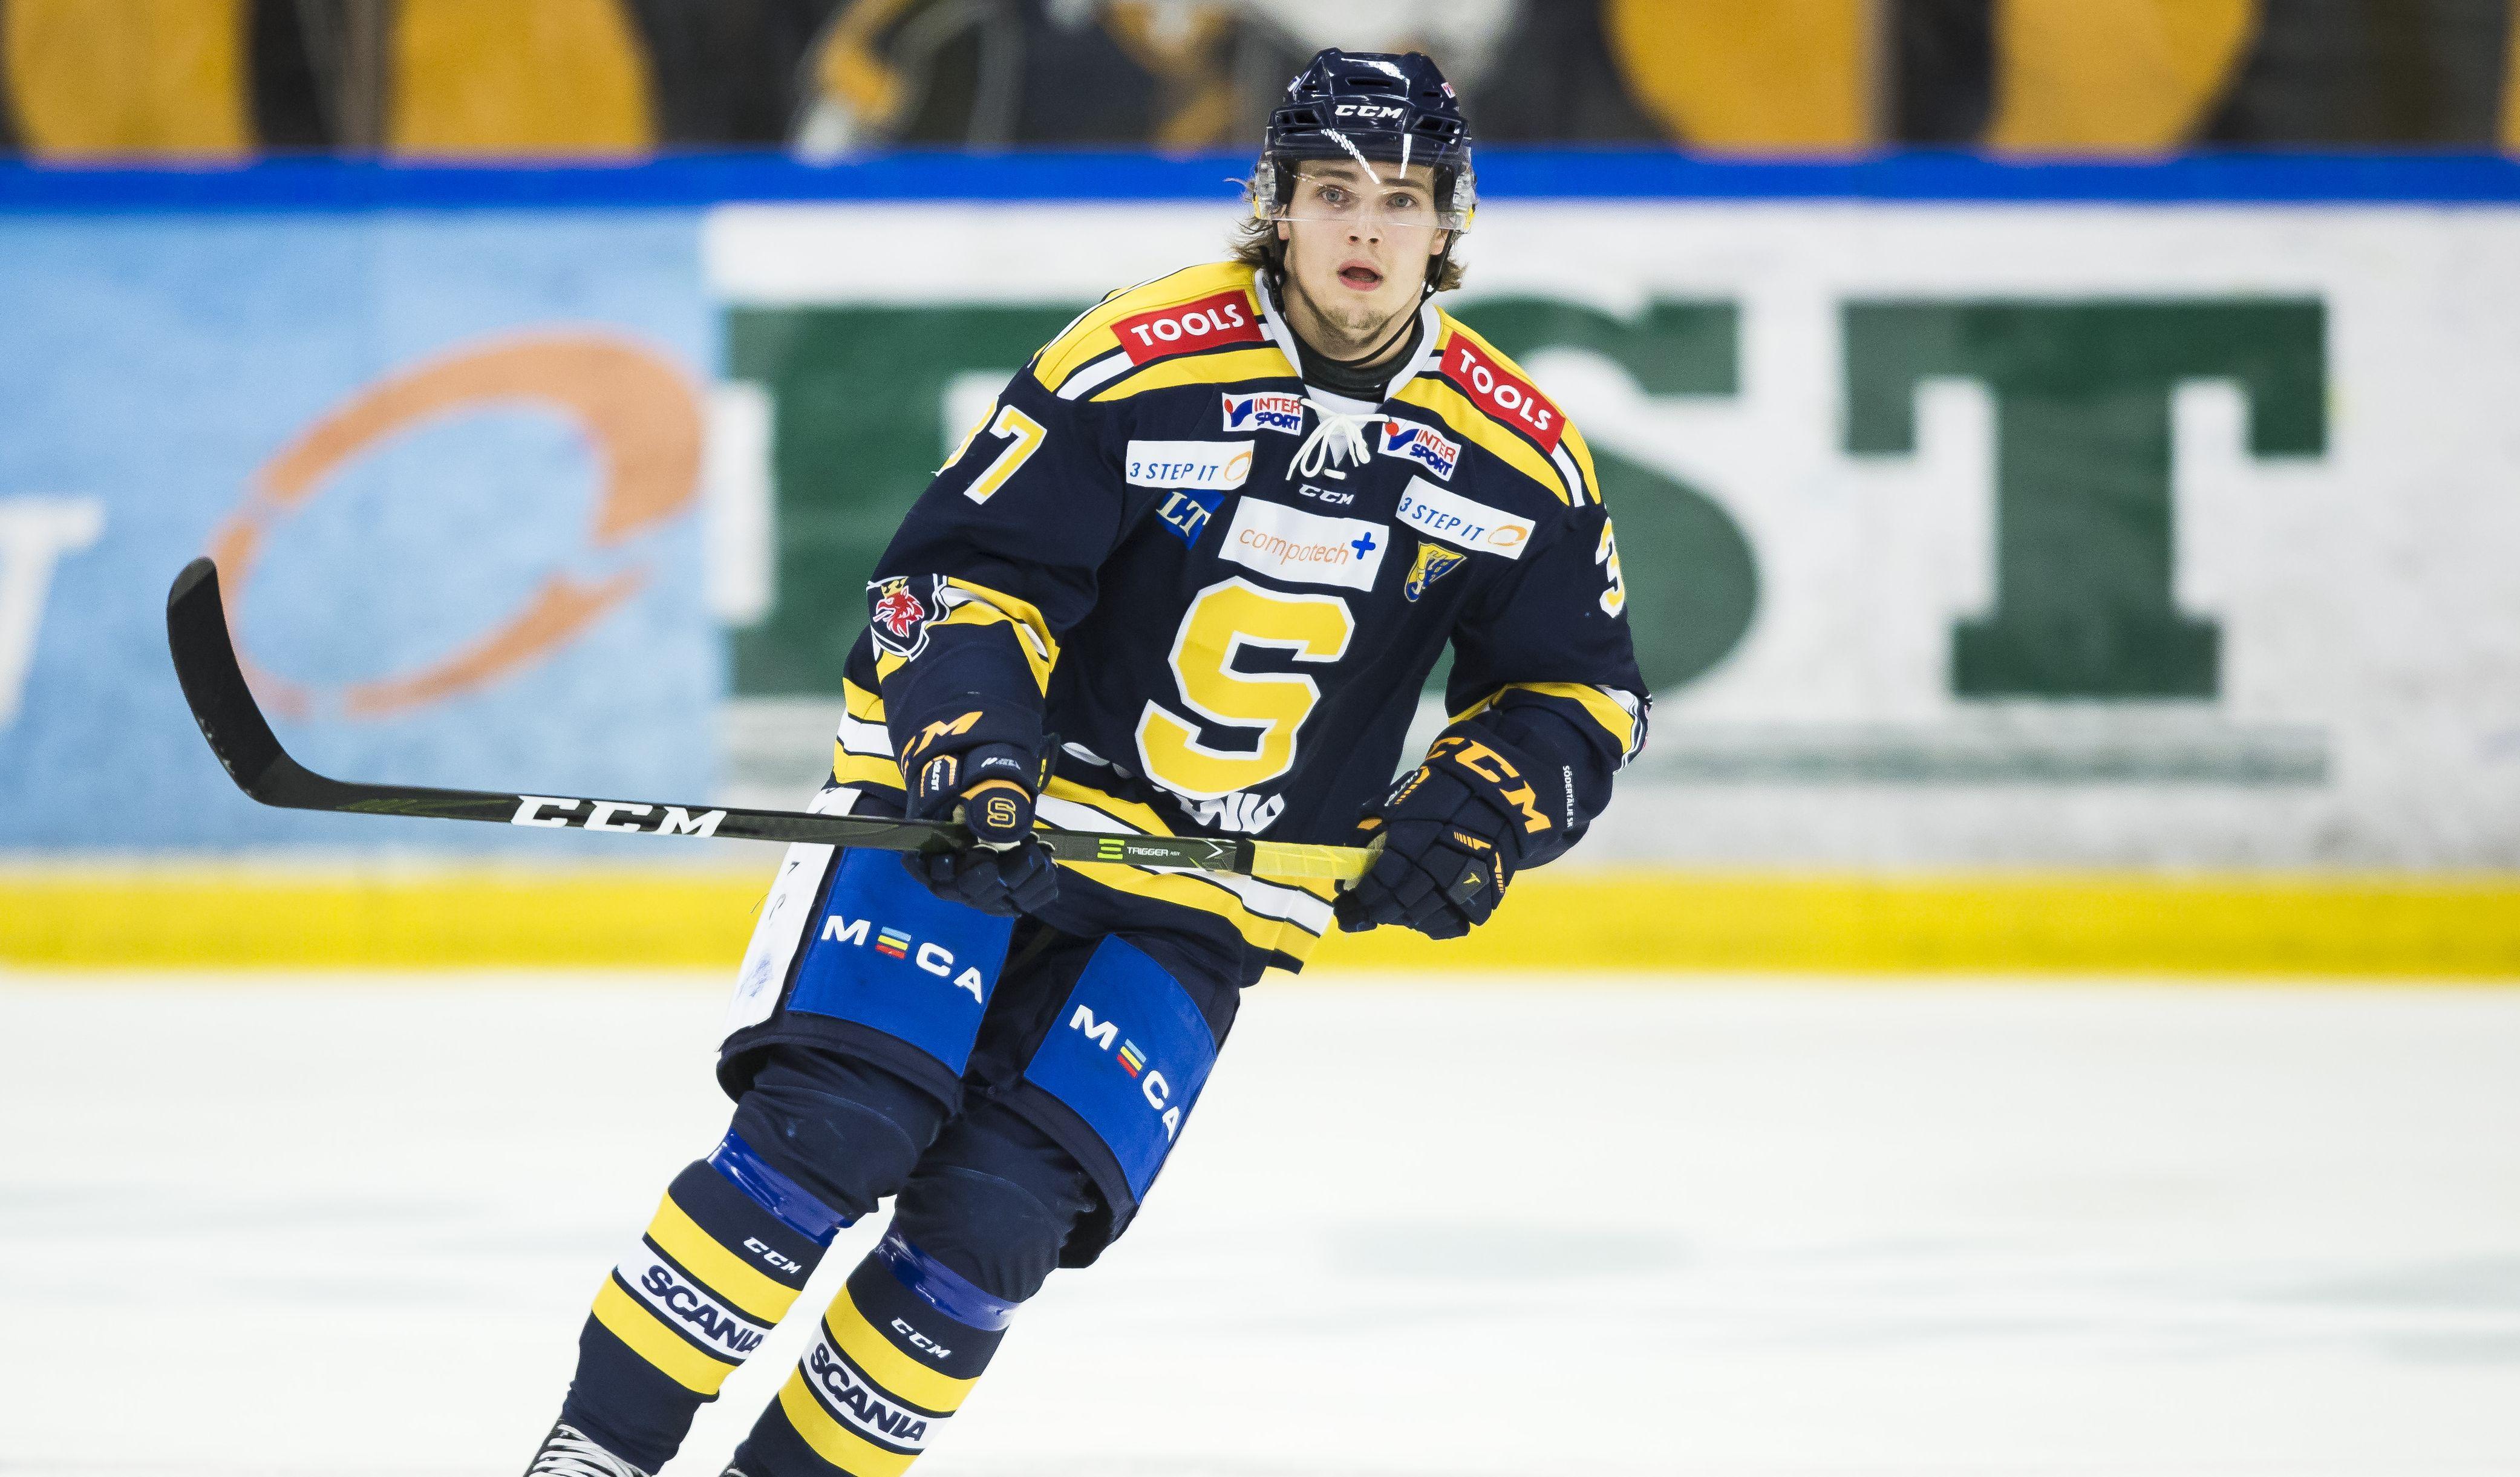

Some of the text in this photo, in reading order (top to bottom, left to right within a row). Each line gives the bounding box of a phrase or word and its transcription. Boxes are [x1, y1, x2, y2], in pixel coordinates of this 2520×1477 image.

[1334, 105, 1404, 119] CCM
[1130, 303, 1245, 347] TOOLS
[1254, 397, 1301, 416] INTER
[1459, 348, 1552, 431] TOOLS
[1254, 412, 1301, 432] SPORT
[1409, 443, 1453, 475] SPORT
[1417, 429, 1457, 463] INTER
[1129, 461, 1219, 481] 3 STEP IT
[1155, 491, 1212, 538] LT
[1298, 484, 1354, 506] CCM
[1399, 497, 1485, 542] 3 STEP IT
[1595, 516, 1625, 619] 3
[1135, 575, 1356, 801] S
[1425, 736, 1552, 833] CCM
[1562, 765, 1575, 817] SÖDERTÄLJE
[509, 794, 726, 838] CCM
[987, 796, 1016, 828] S
[1126, 846, 1169, 857] TRIGGER
[821, 915, 984, 1005] MECA
[1069, 1003, 1180, 1143] MECA
[743, 1236, 802, 1274] CCM
[641, 1265, 764, 1354] SCANIA
[890, 1316, 952, 1360] CCM
[809, 1342, 927, 1443] SCANIA
